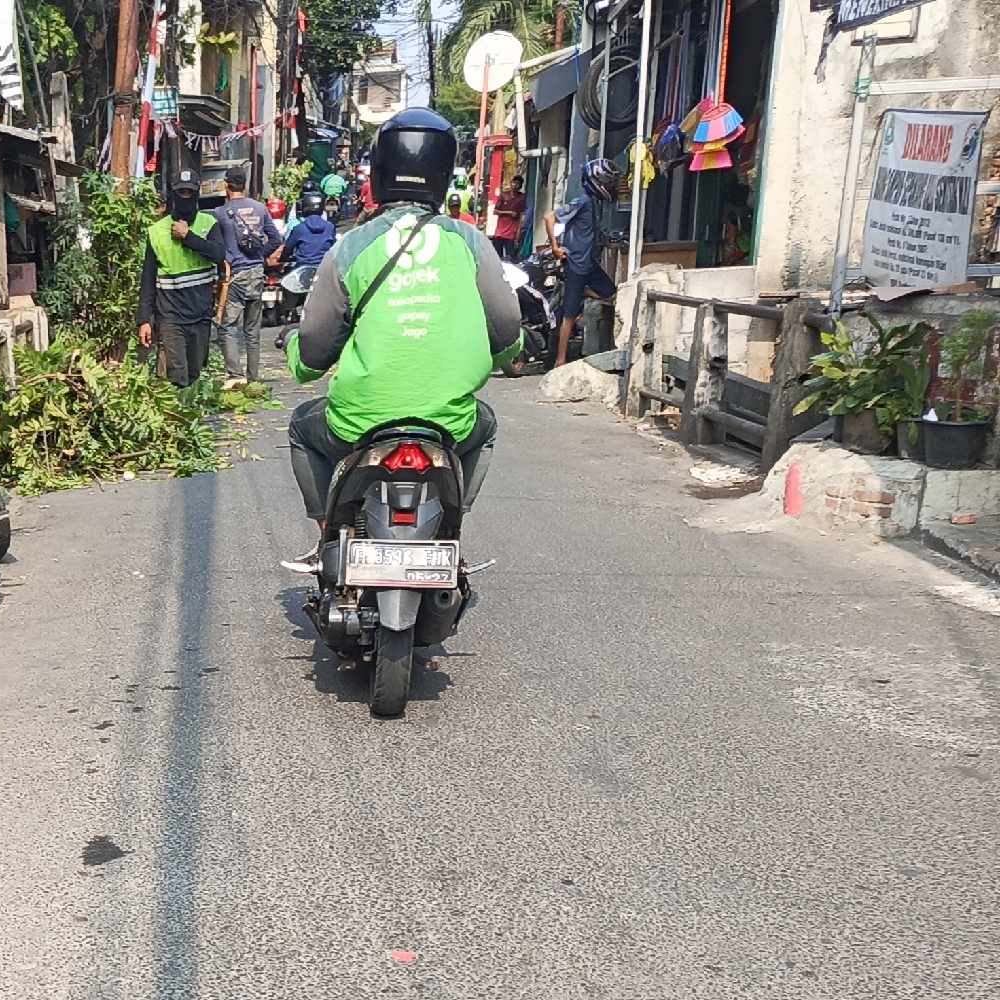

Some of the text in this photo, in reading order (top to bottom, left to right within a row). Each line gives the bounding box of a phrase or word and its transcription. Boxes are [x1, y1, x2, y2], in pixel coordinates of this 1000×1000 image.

[901, 123, 954, 164] DILARANG
[395, 175, 426, 184] HONDA
[389, 266, 441, 292] gojek
[388, 293, 441, 307] tokopedia
[397, 310, 432, 323] gopay
[401, 326, 428, 339] Jago
